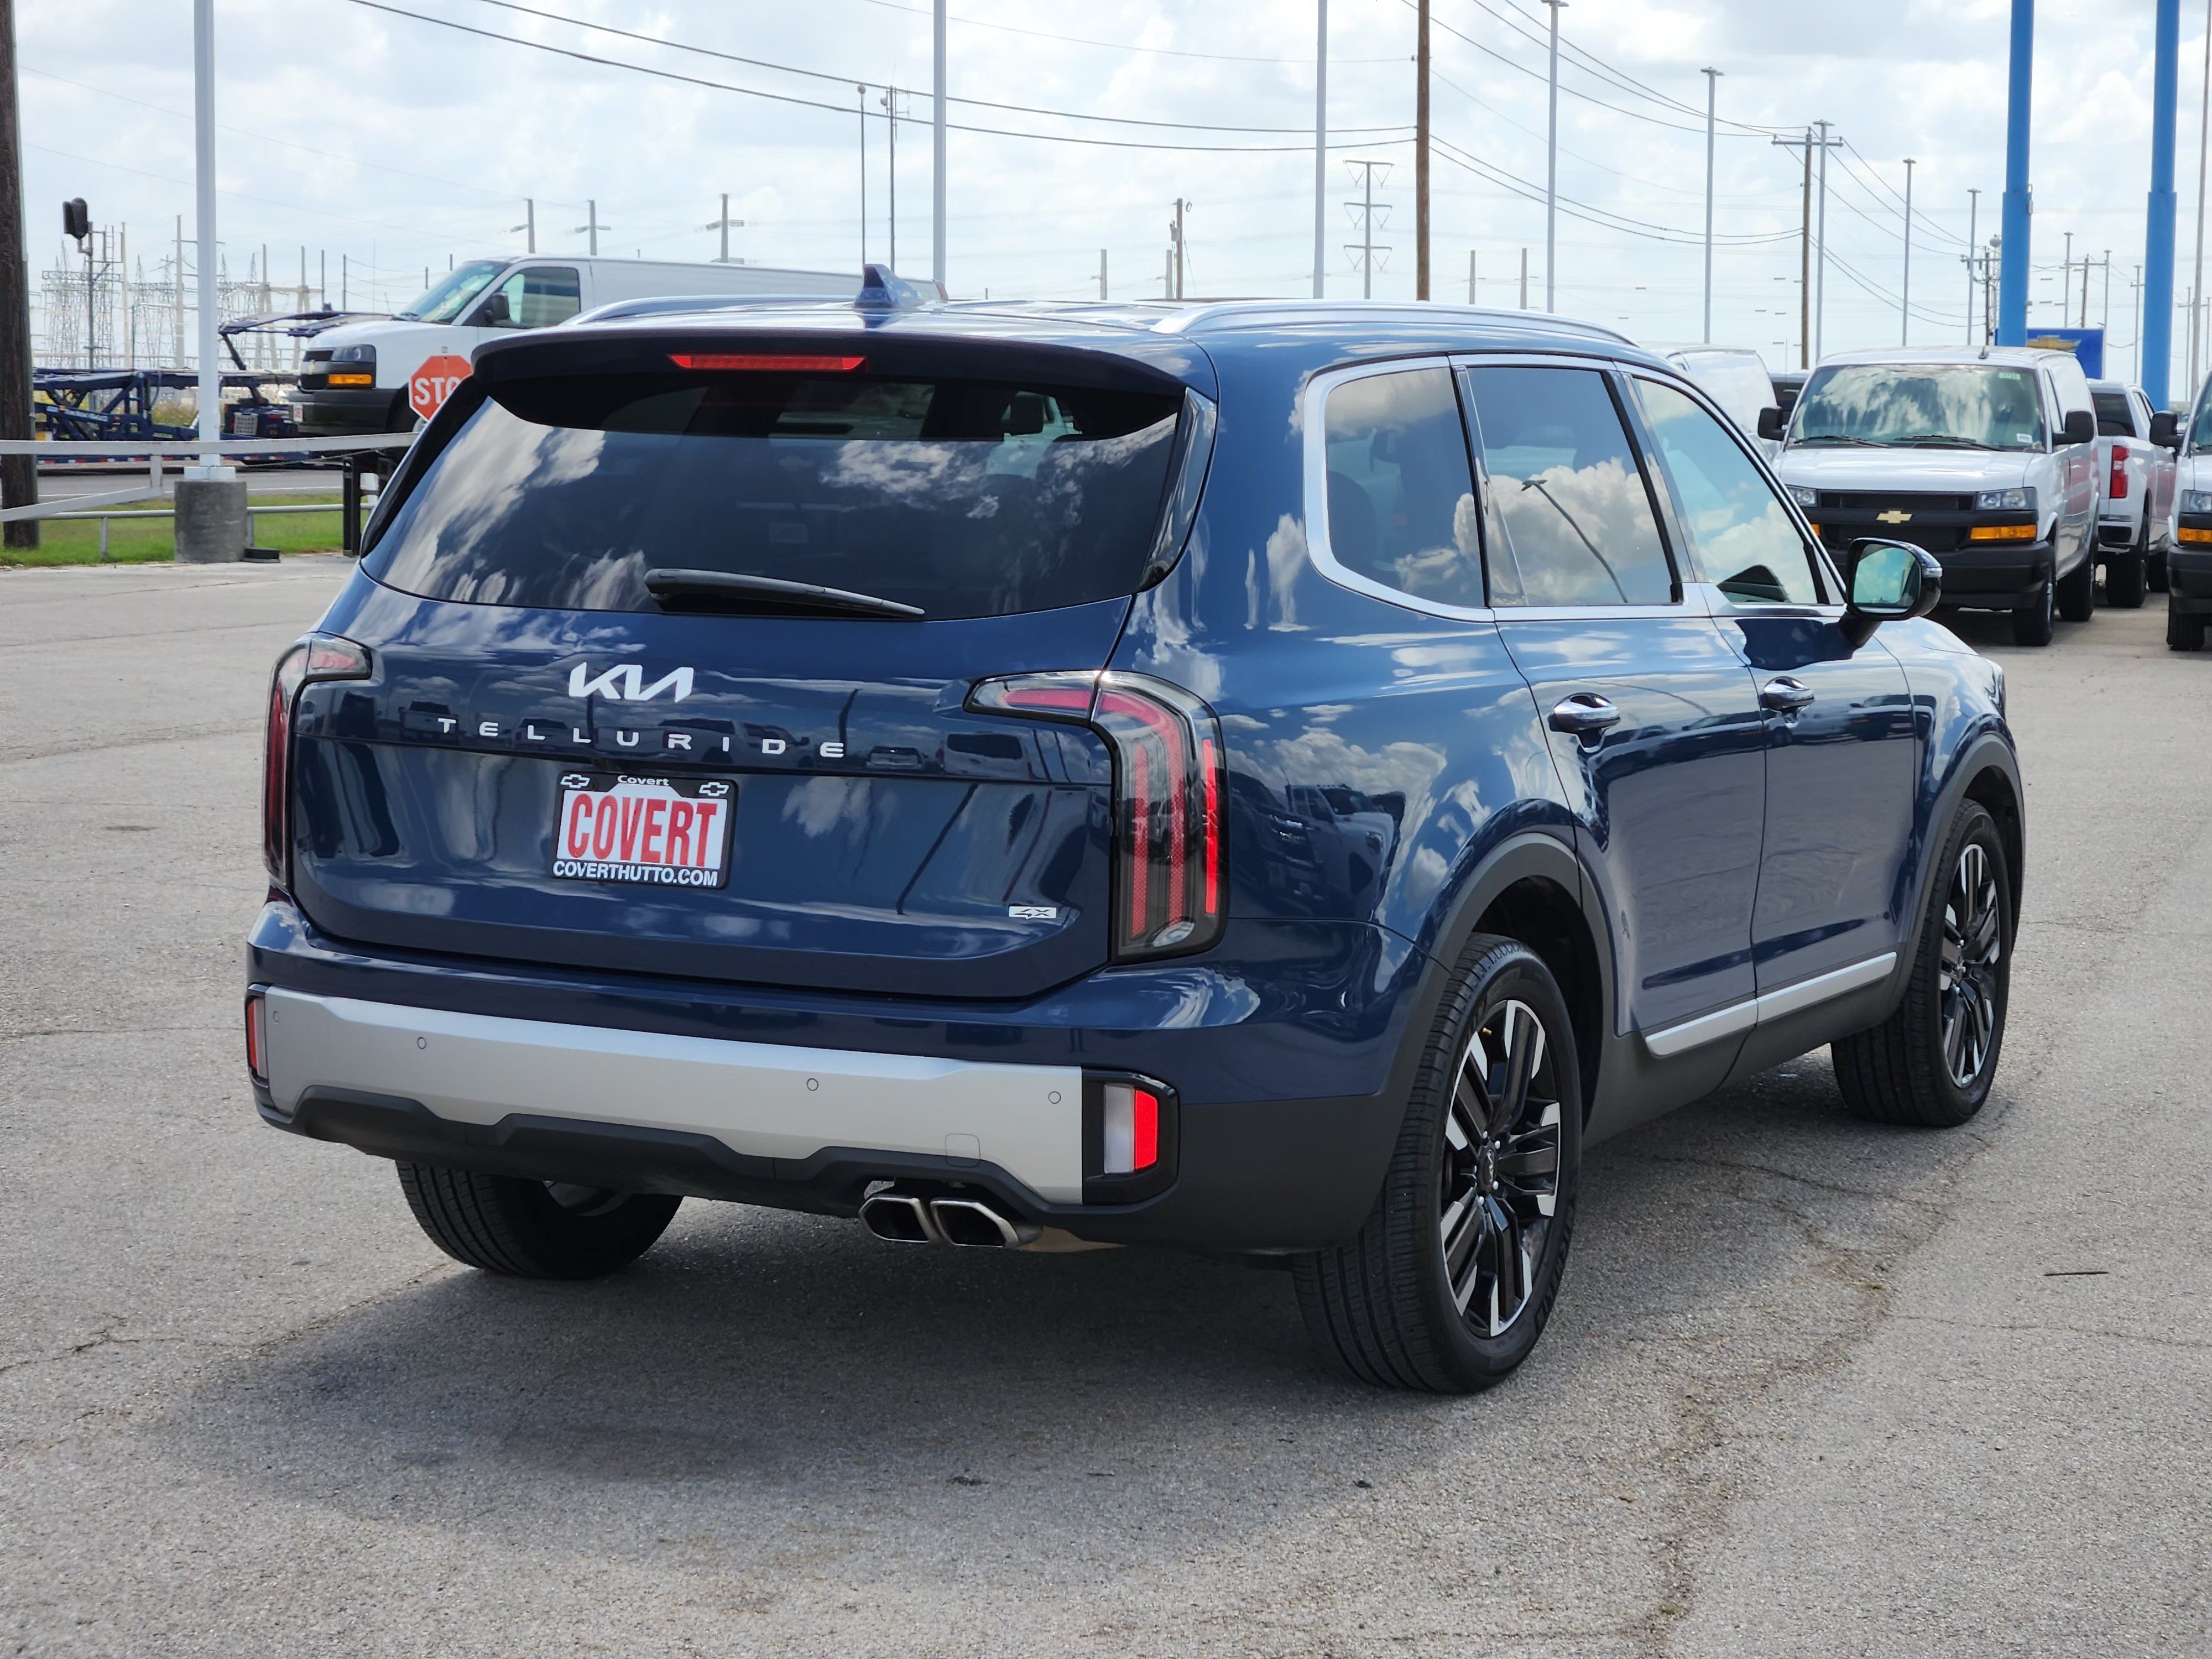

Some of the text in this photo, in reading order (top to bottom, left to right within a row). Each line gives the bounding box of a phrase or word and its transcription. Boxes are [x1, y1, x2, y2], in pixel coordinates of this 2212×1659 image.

[414, 377, 461, 405] STO
[568, 662, 693, 702] KIA
[437, 718, 844, 758] TELLURIDE
[617, 775, 669, 786] Covert
[567, 794, 718, 867] COVERT
[553, 861, 718, 886] COVERTHUTTO.COM
